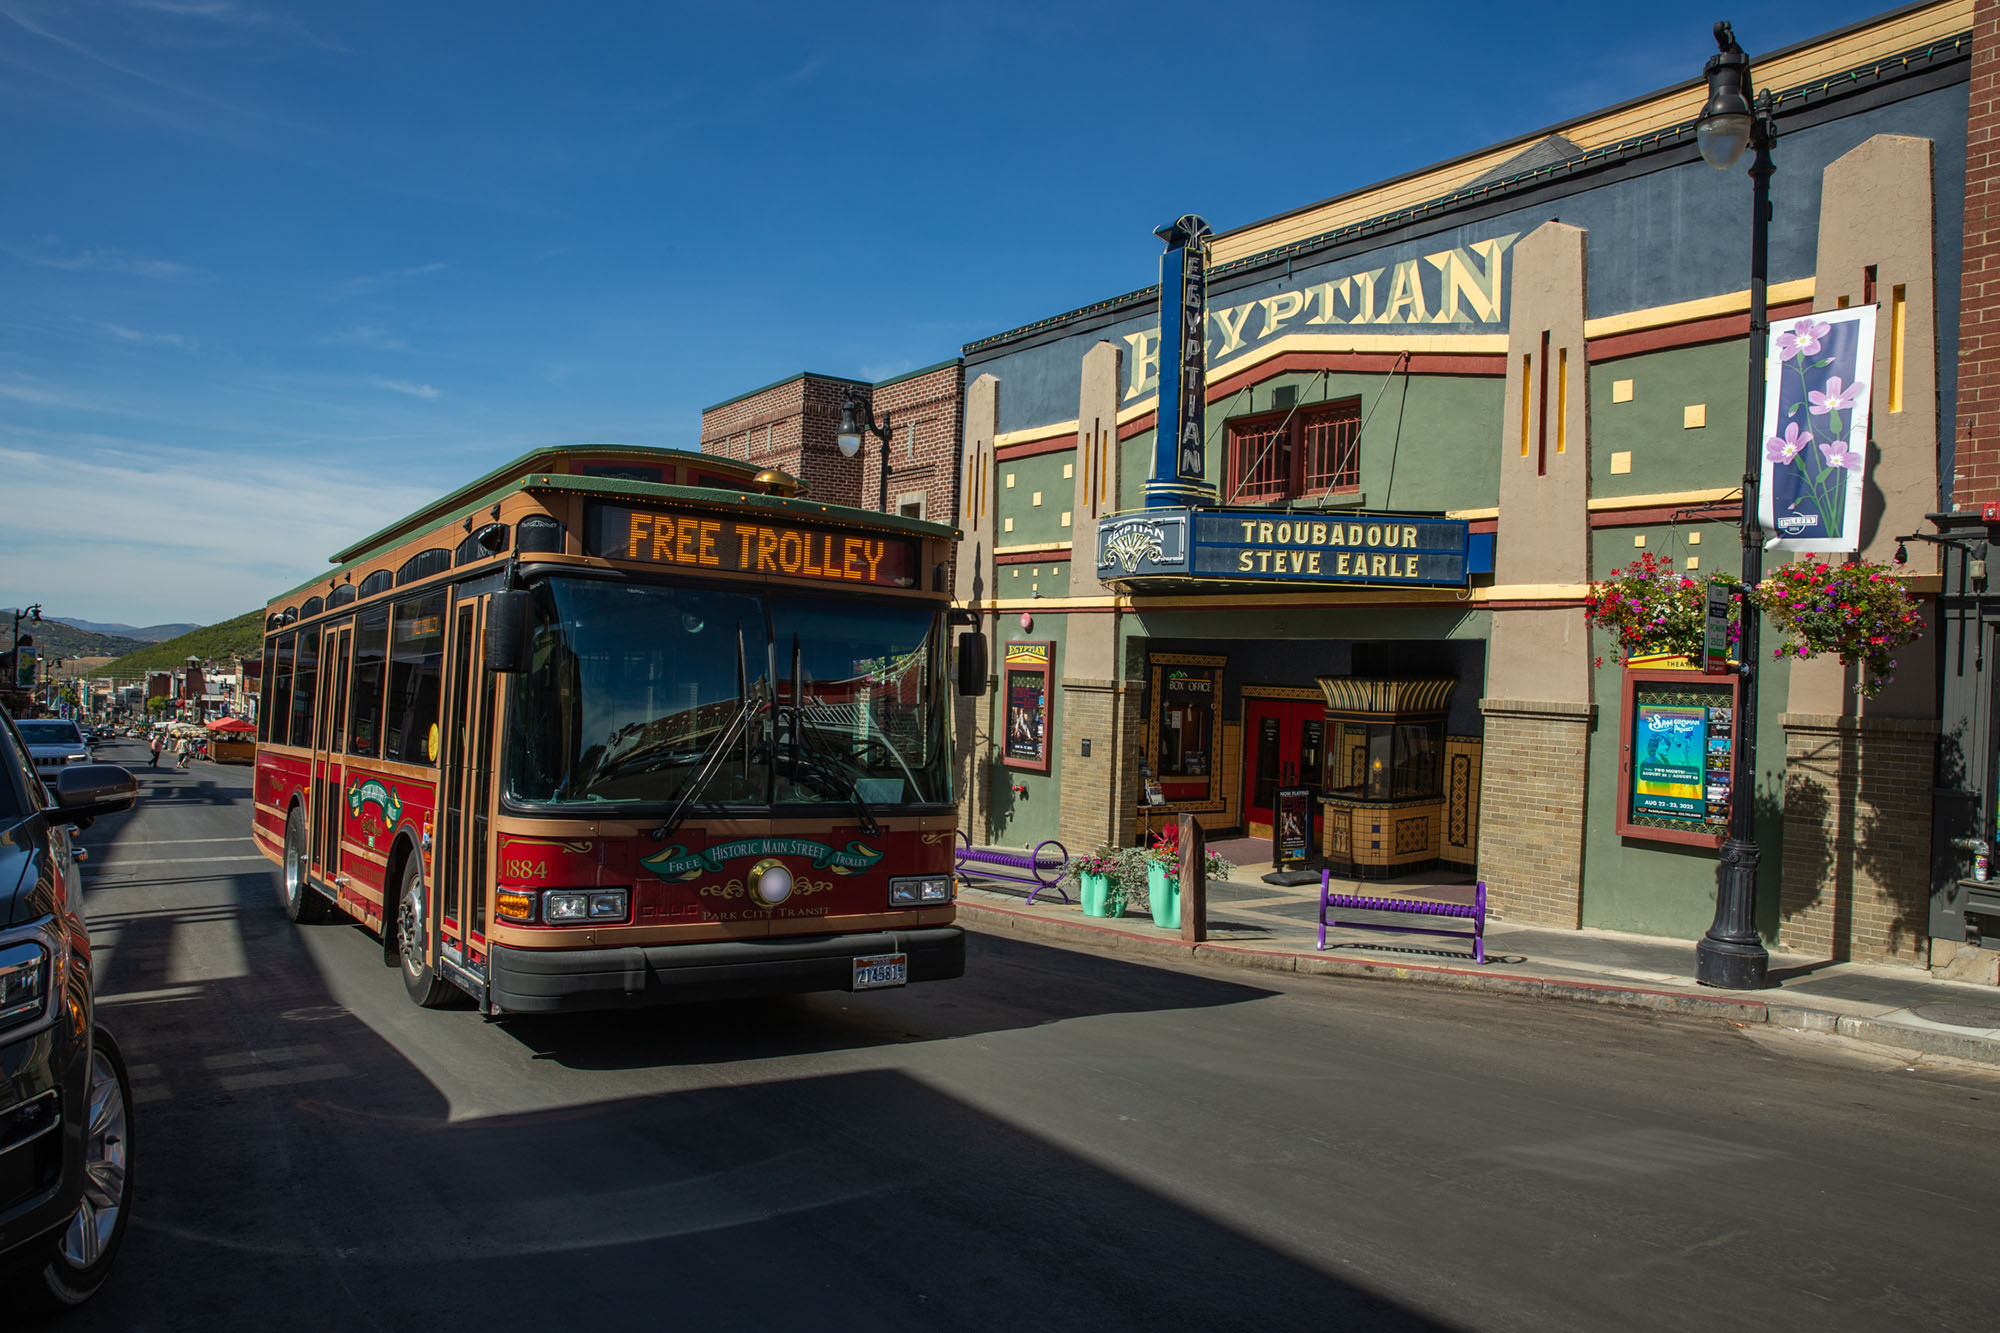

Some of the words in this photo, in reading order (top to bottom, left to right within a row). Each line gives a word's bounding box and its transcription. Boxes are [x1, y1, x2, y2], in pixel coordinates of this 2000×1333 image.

[1124, 231, 1521, 402] EYPTIAN
[1181, 256, 1202, 474] EGYPTIAN
[629, 513, 721, 566] FREE
[735, 523, 885, 581] TROLLEY
[1107, 524, 1165, 547] EGYPTIAN
[1240, 519, 1418, 548] TROUBADOUR
[1238, 549, 1321, 574] STEVE
[1336, 551, 1419, 578] EARLE
[1008, 645, 1046, 656] EGYPTIAN
[1169, 680, 1185, 692] BOX
[1188, 682, 1212, 693] OFFICE
[504, 858, 549, 880] 1884
[668, 854, 700, 873] FREE
[712, 842, 759, 862] HISTORIC
[762, 839, 788, 854] MAIN
[790, 840, 825, 860] STREET
[835, 851, 868, 868] TROLLEY
[703, 911, 737, 921] PARK
[742, 909, 773, 920] CITY
[778, 906, 832, 918] TRANSIT
